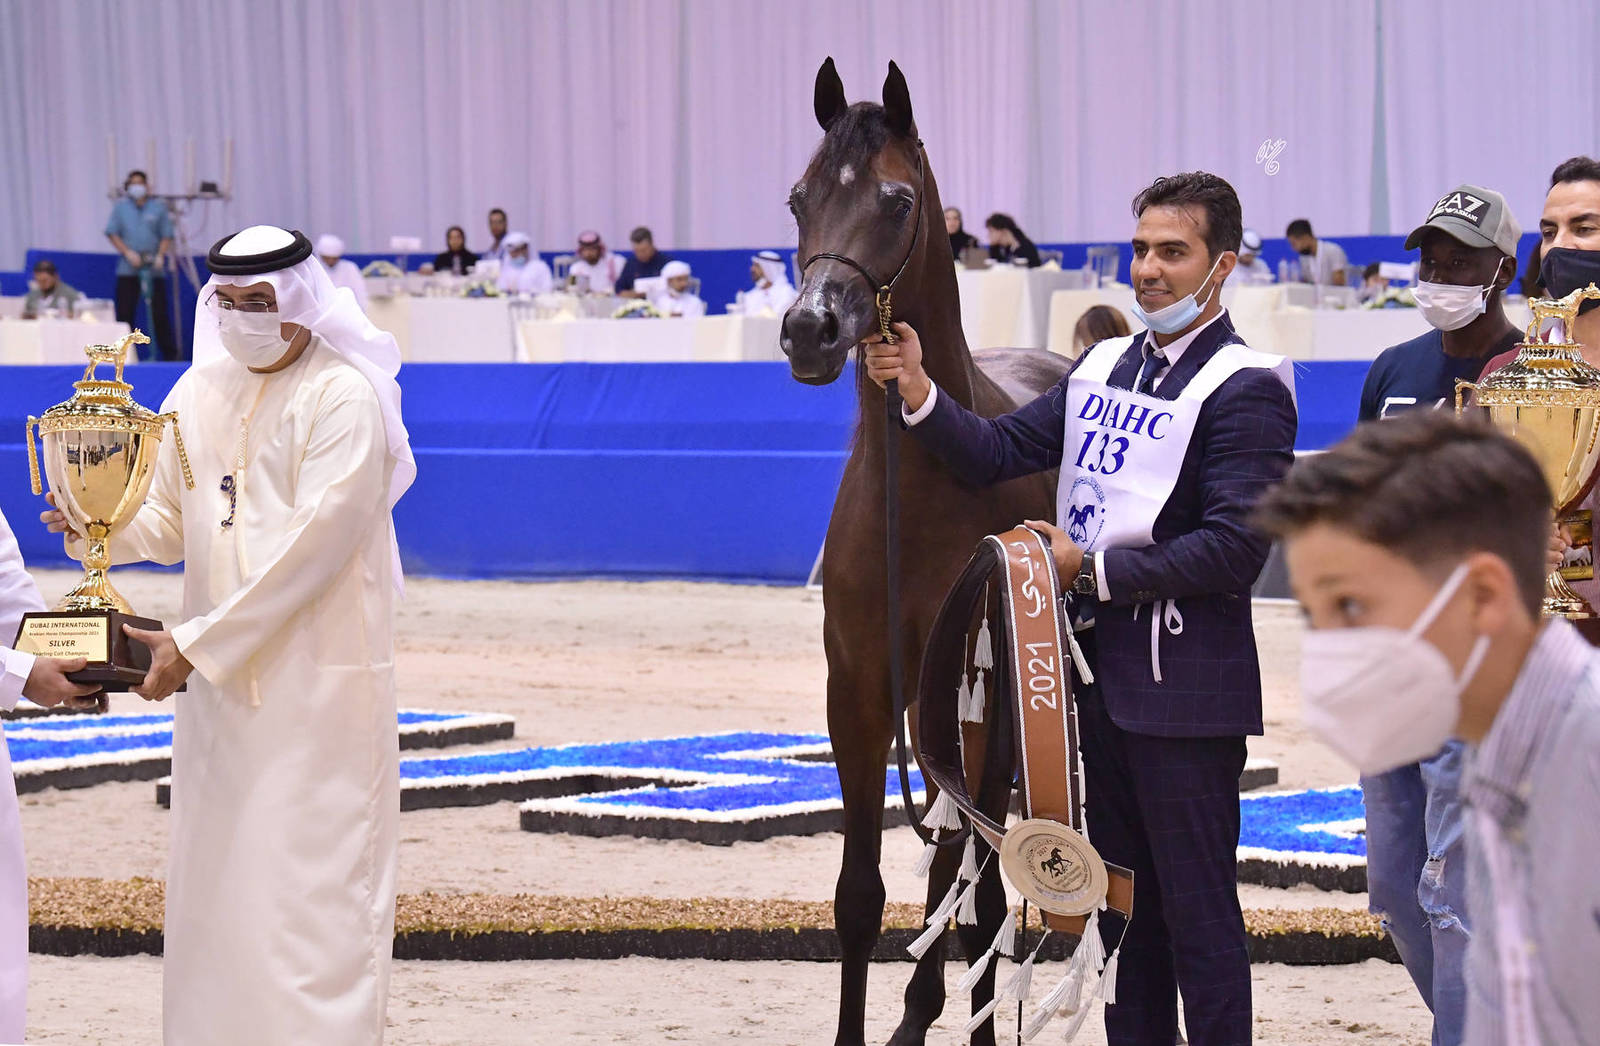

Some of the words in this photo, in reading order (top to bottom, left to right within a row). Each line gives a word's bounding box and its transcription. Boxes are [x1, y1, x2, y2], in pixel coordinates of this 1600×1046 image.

[1433, 193, 1484, 213] EA7
[1077, 392, 1174, 440] DIAHC
[1074, 430, 1130, 475] 133
[1025, 642, 1057, 711] 2021
